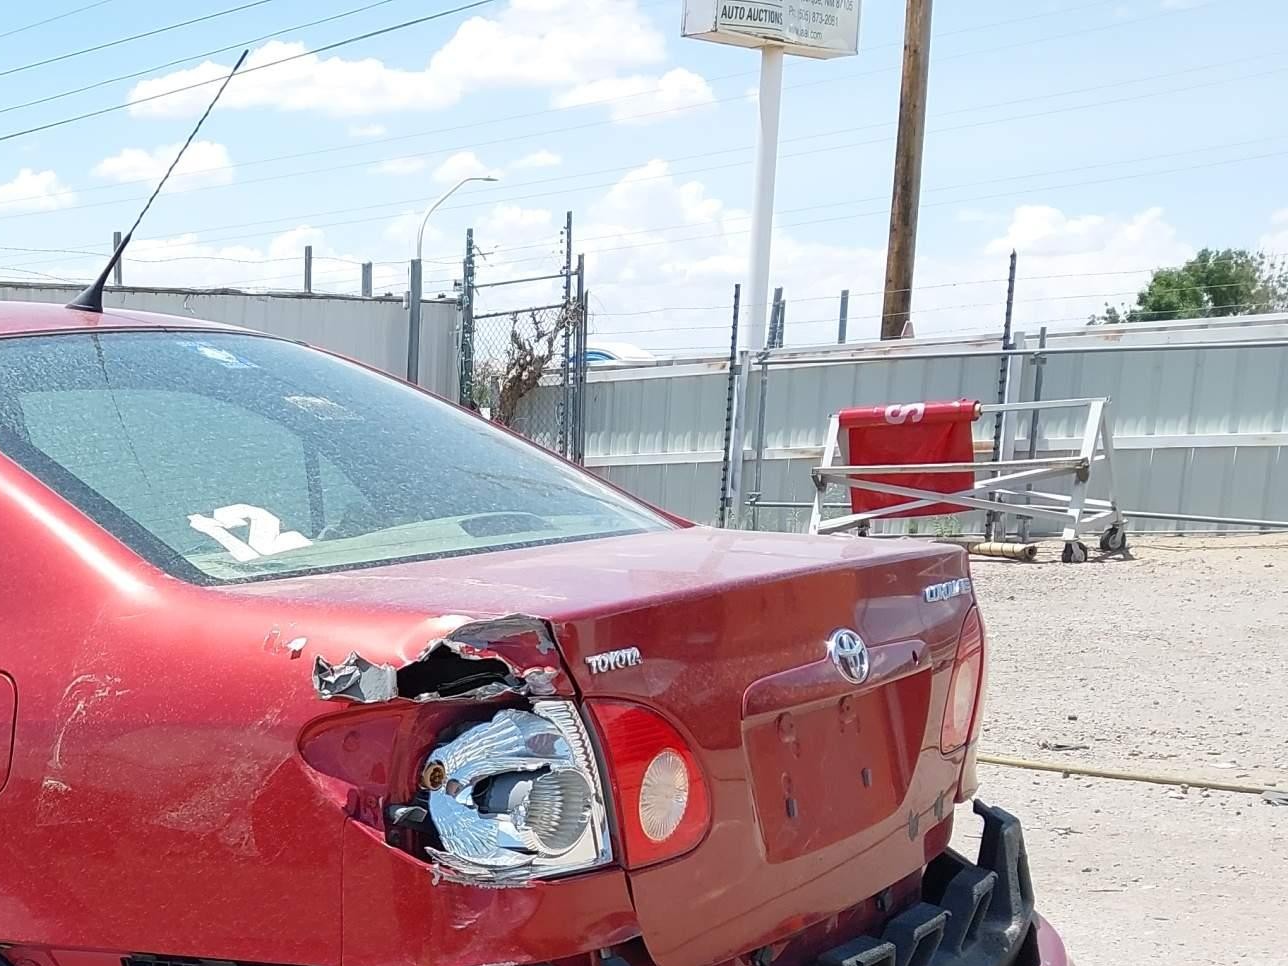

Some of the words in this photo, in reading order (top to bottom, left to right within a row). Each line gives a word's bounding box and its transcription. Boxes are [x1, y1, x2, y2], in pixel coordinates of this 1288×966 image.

[721, 4, 746, 20] AUTO
[746, 7, 783, 26] AUCTIONS
[584, 646, 643, 675] TOYOTA
